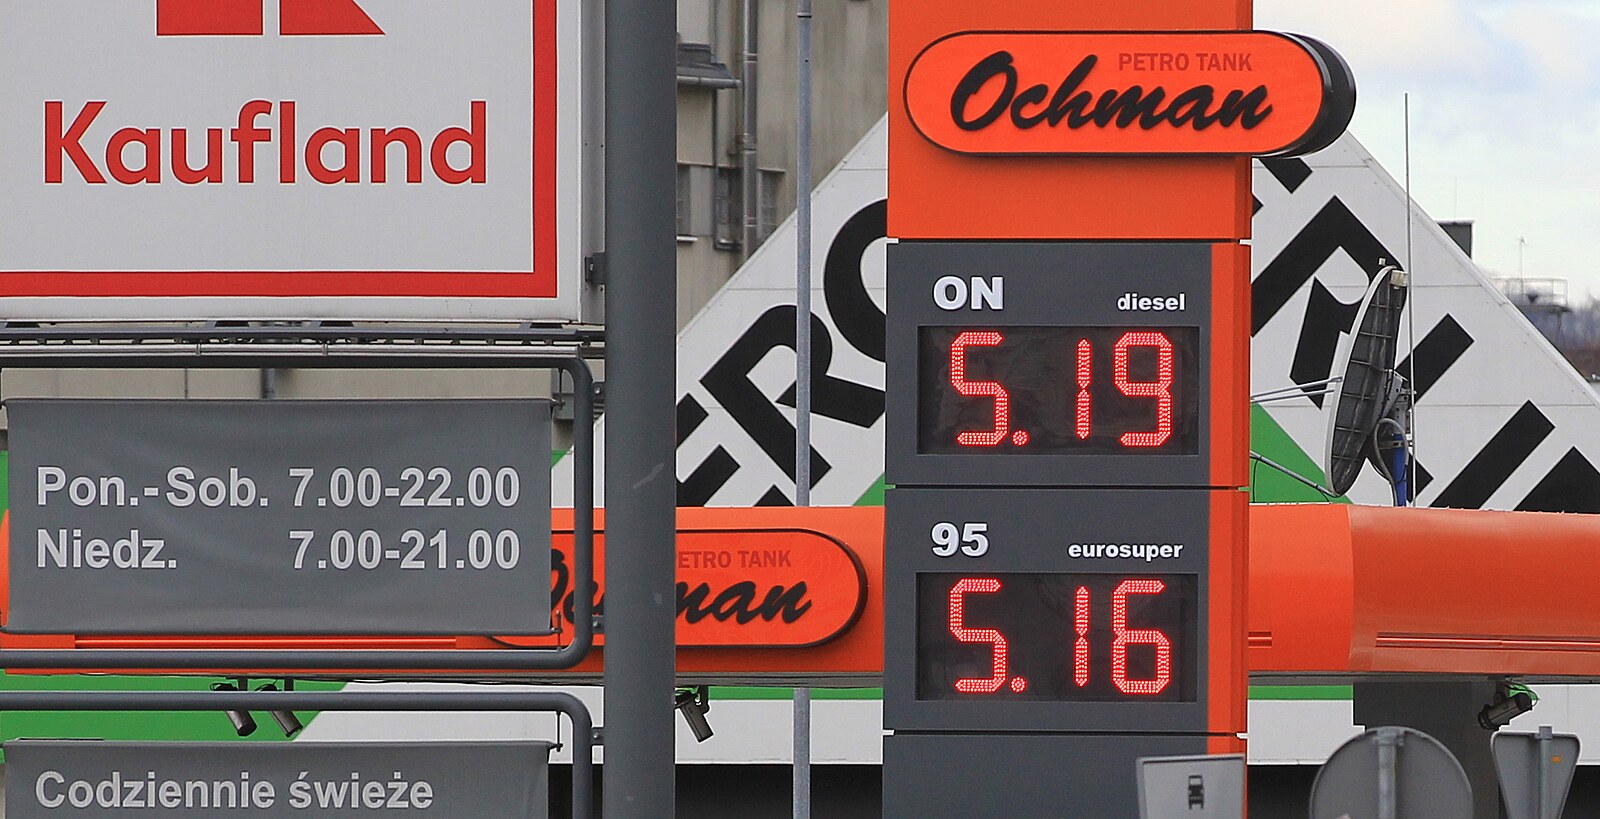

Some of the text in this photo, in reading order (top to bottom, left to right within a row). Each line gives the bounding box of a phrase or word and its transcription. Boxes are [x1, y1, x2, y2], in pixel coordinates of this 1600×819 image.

[1118, 52, 1253, 72] PETRO TANK
[950, 50, 1273, 131] Ochman
[44, 99, 487, 185] Kaufland
[933, 275, 1186, 311] ON diesel
[949, 331, 1173, 447] 5.19
[289, 467, 520, 508] 7.00-22.00
[36, 528, 520, 570] Niedz. 7.00-21.00
[677, 550, 792, 569] ETRO TANK
[931, 522, 1184, 562] 95 eurosuper
[949, 578, 1171, 694] 5.16
[35, 770, 433, 809] Codziennie świeże
